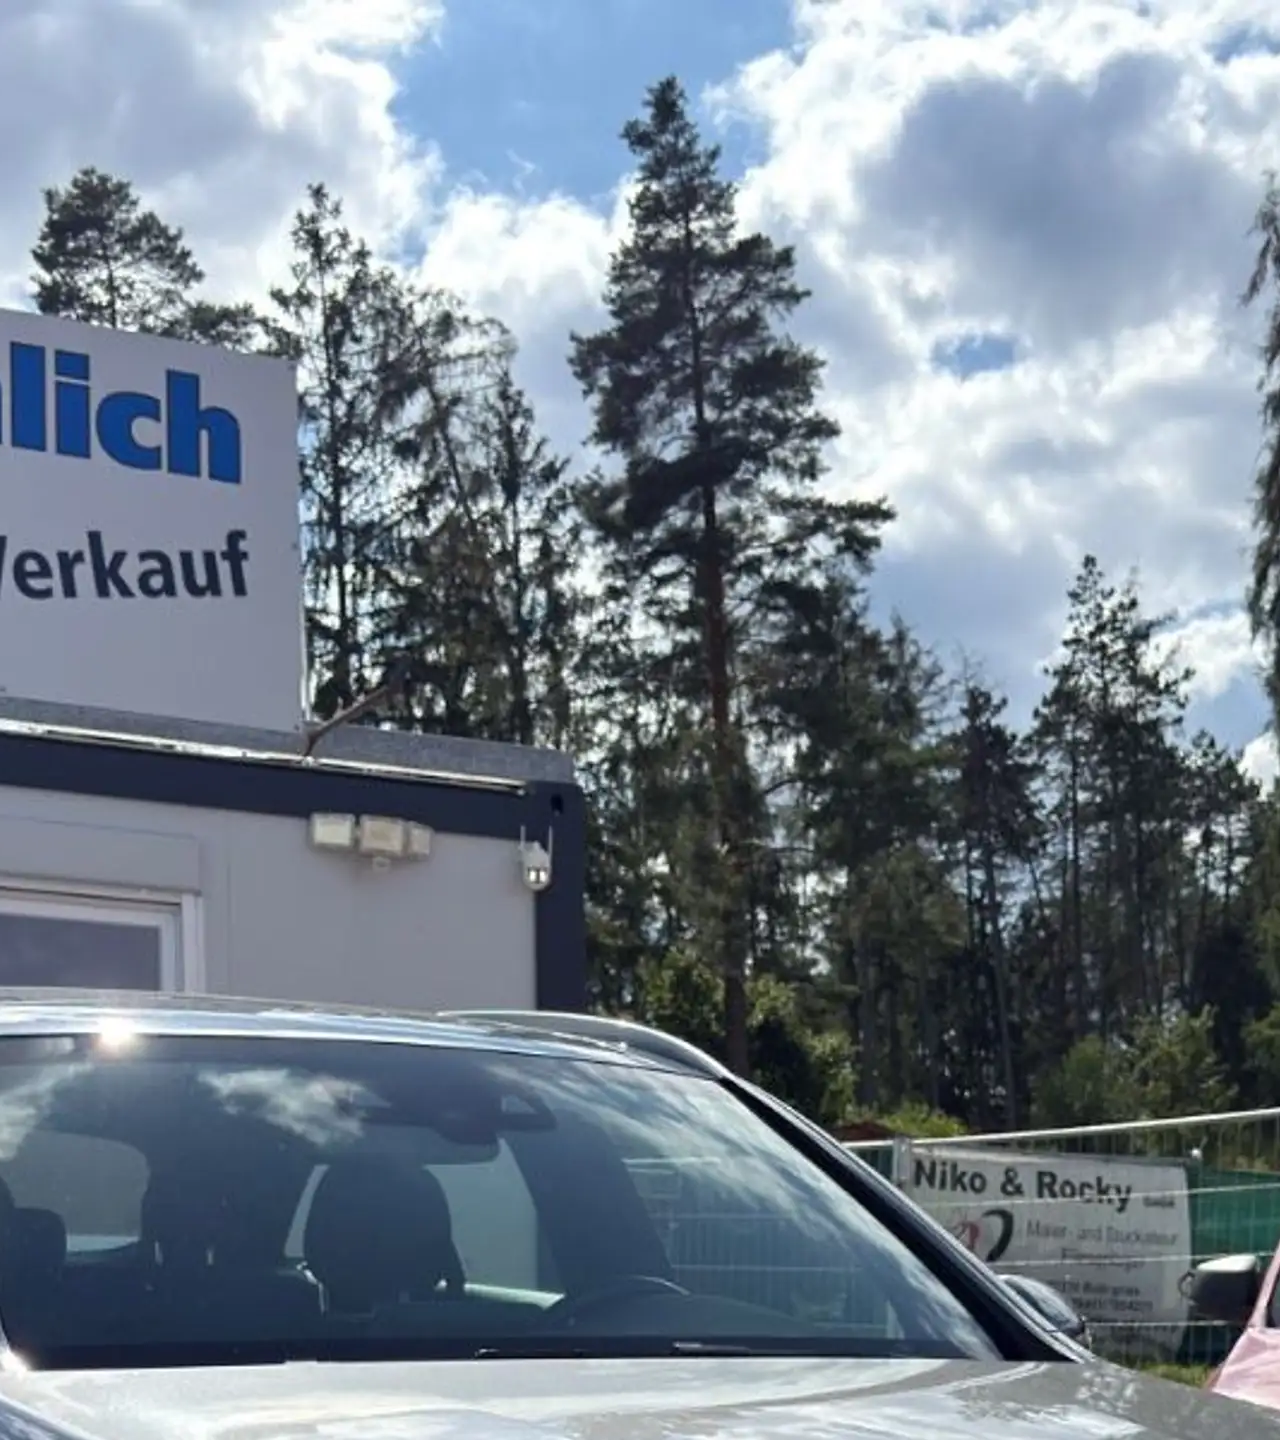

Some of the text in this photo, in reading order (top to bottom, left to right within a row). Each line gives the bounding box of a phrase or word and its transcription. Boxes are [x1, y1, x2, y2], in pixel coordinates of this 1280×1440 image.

[914, 1160, 1132, 1213] Niko & Rocky
